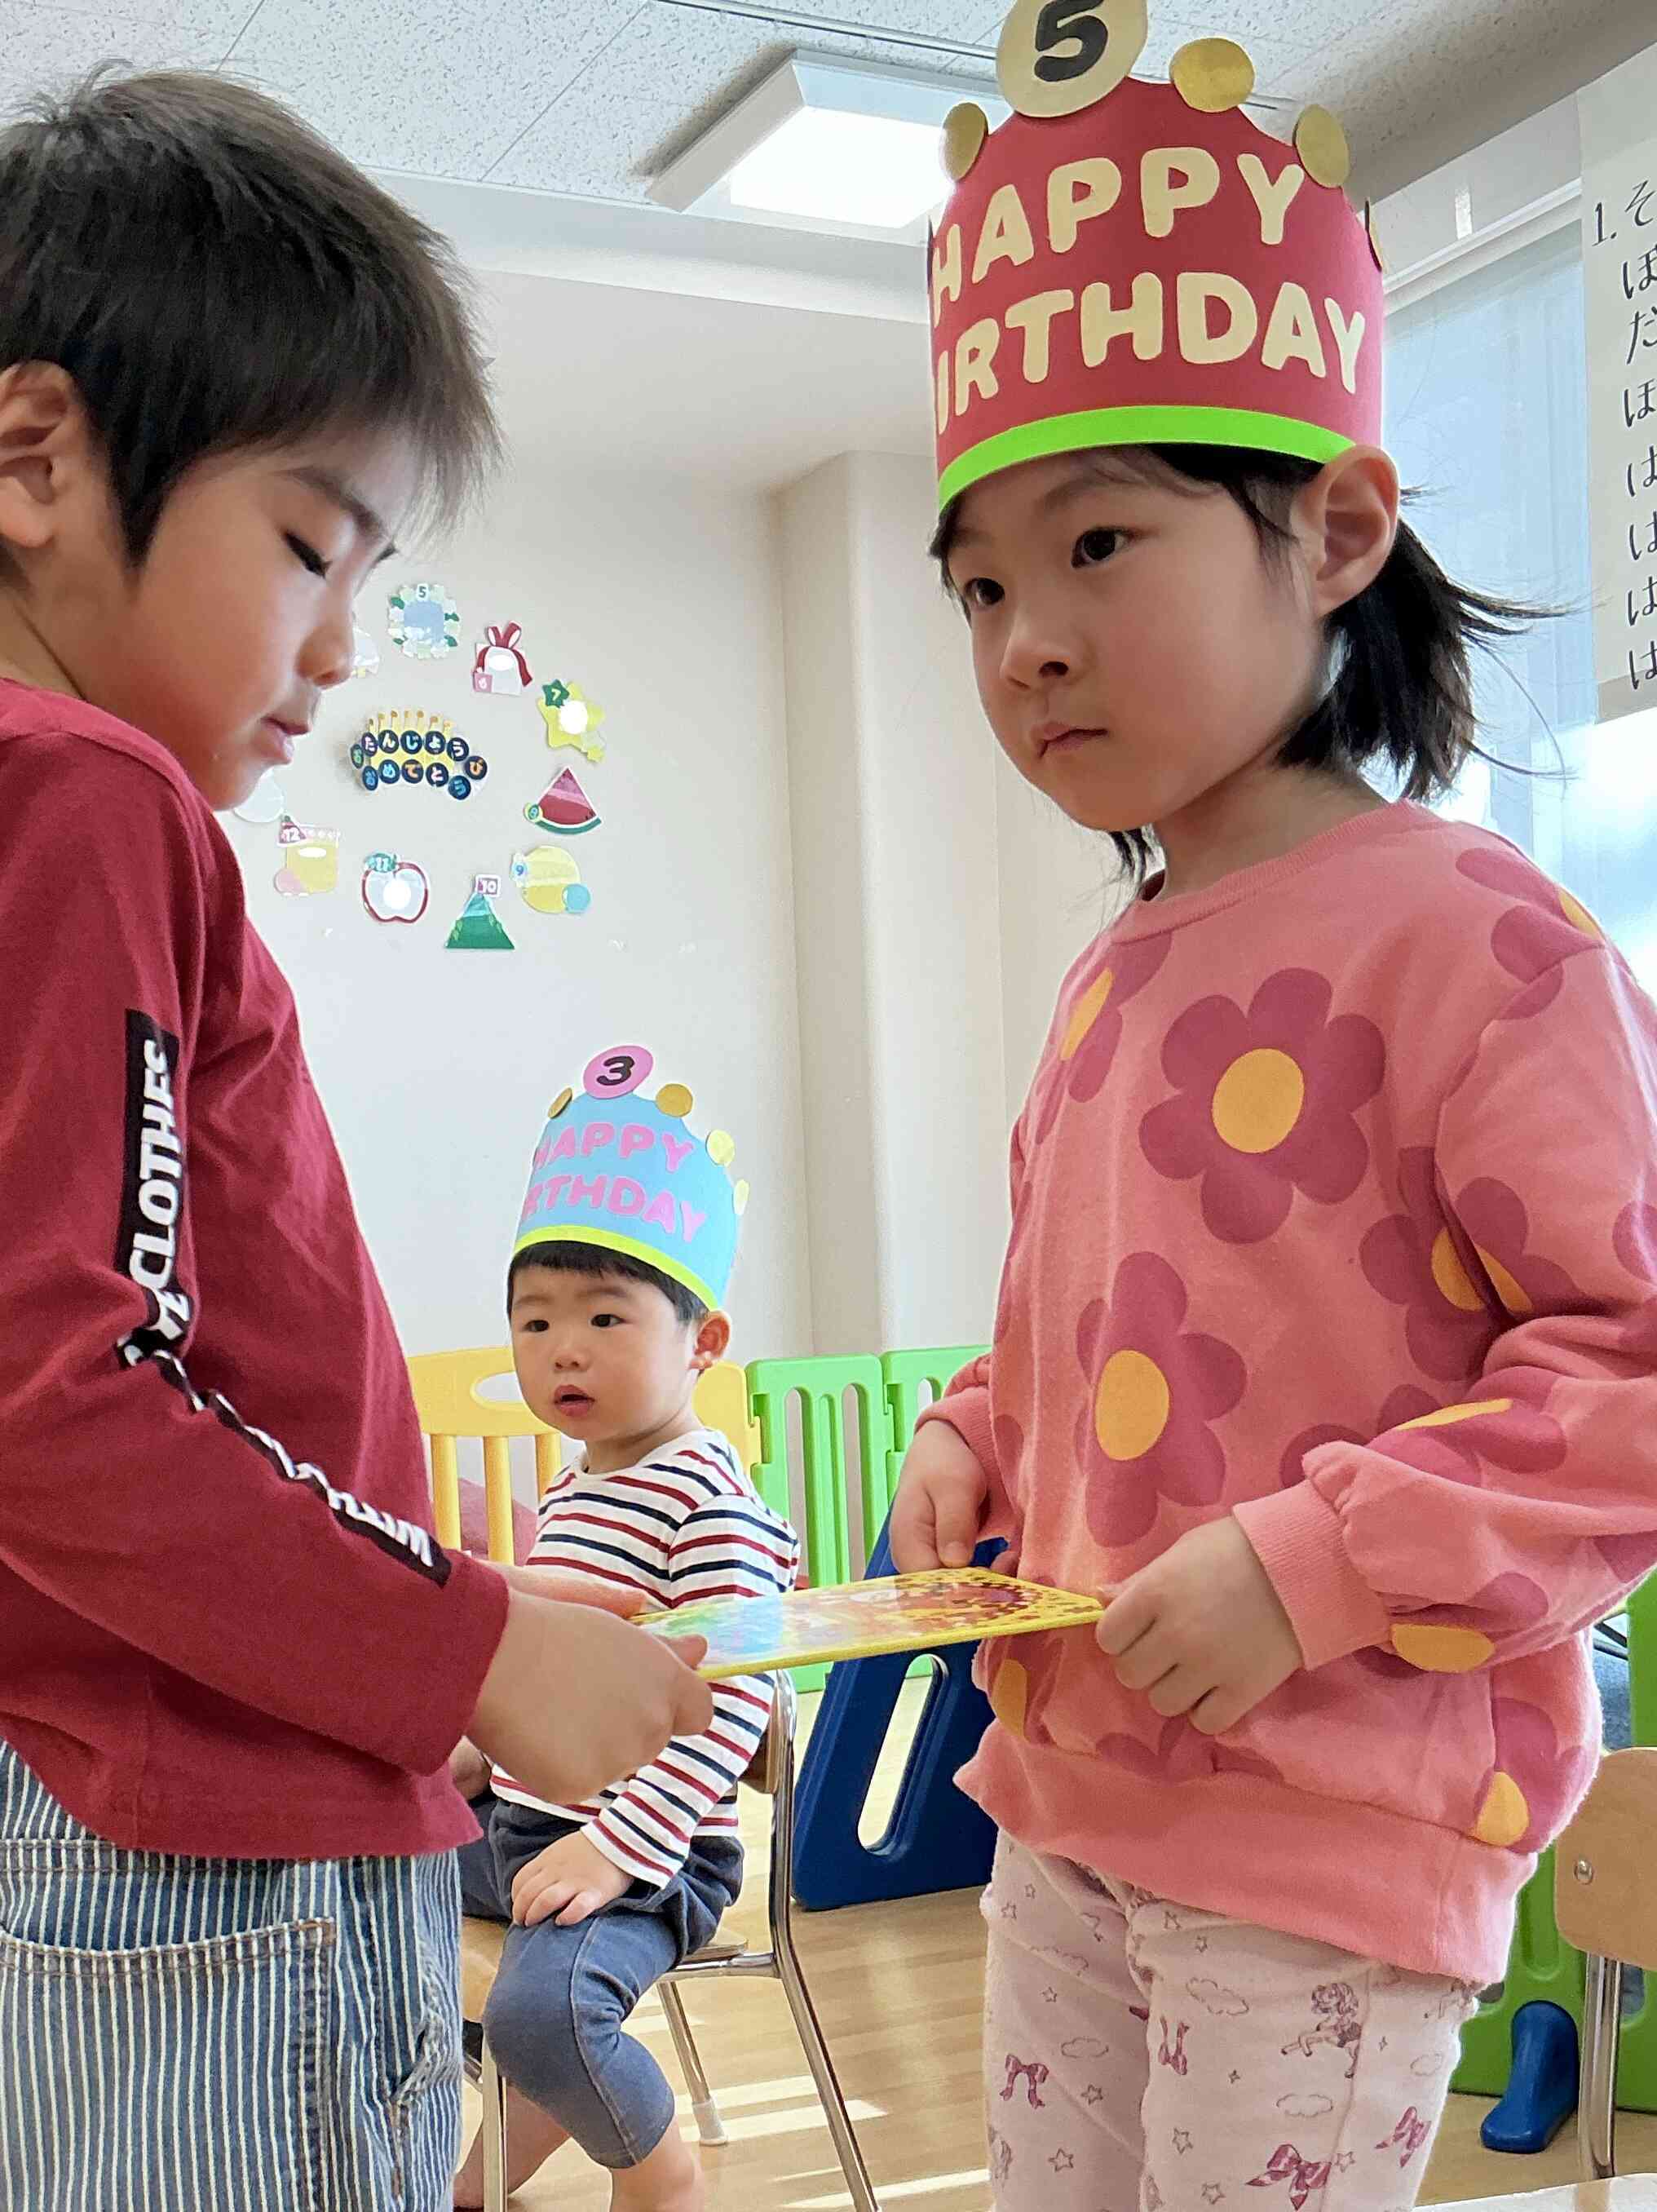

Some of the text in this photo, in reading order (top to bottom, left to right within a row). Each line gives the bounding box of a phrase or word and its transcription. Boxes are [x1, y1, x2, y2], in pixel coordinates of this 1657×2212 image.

[1034, 0, 1108, 82] 5
[932, 146, 1305, 327] HAPPY
[418, 586, 426, 598] 5
[551, 688, 561, 701] 7
[515, 865, 524, 876] 9
[482, 879, 497, 892] 10
[597, 1055, 634, 1086] 3
